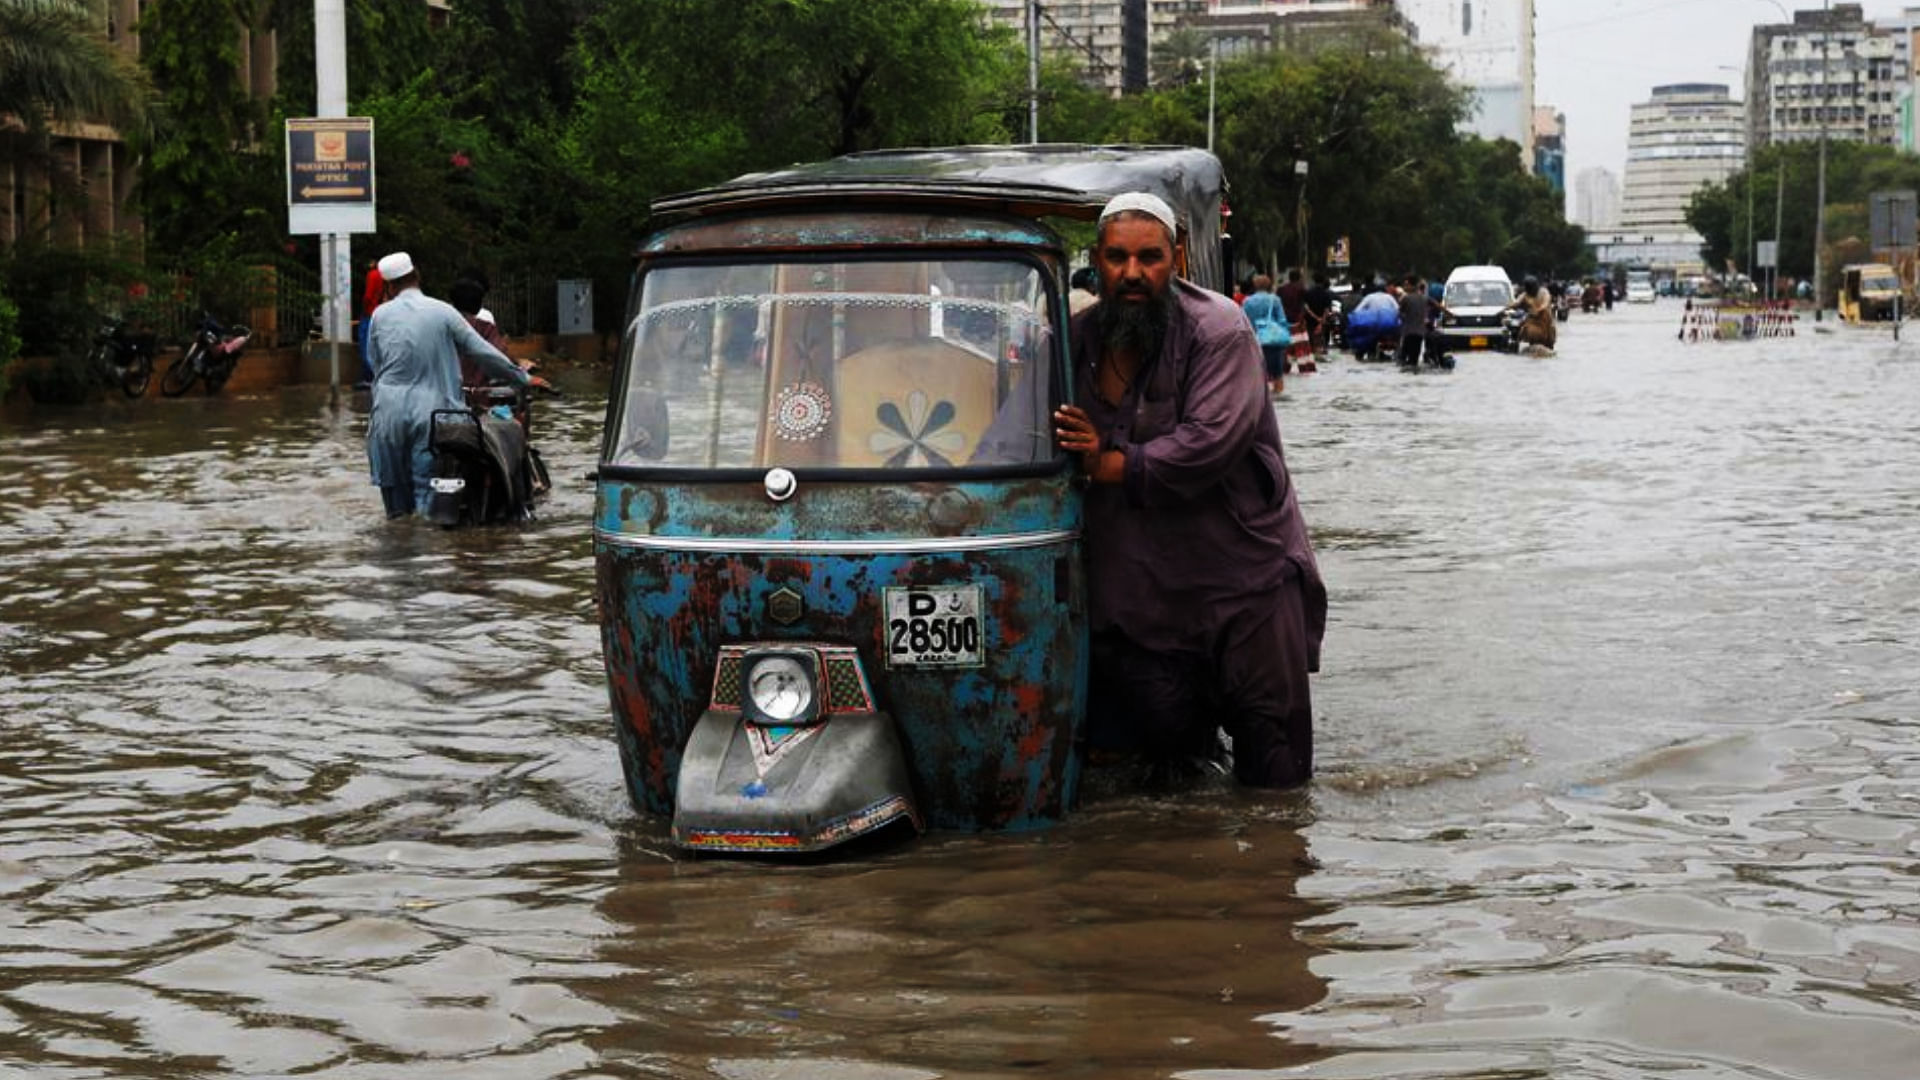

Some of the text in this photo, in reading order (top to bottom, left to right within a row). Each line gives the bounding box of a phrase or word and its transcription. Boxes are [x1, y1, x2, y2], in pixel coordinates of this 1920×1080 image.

[344, 161, 368, 170] POST
[315, 173, 348, 182] OFFICE
[909, 593, 936, 616] D
